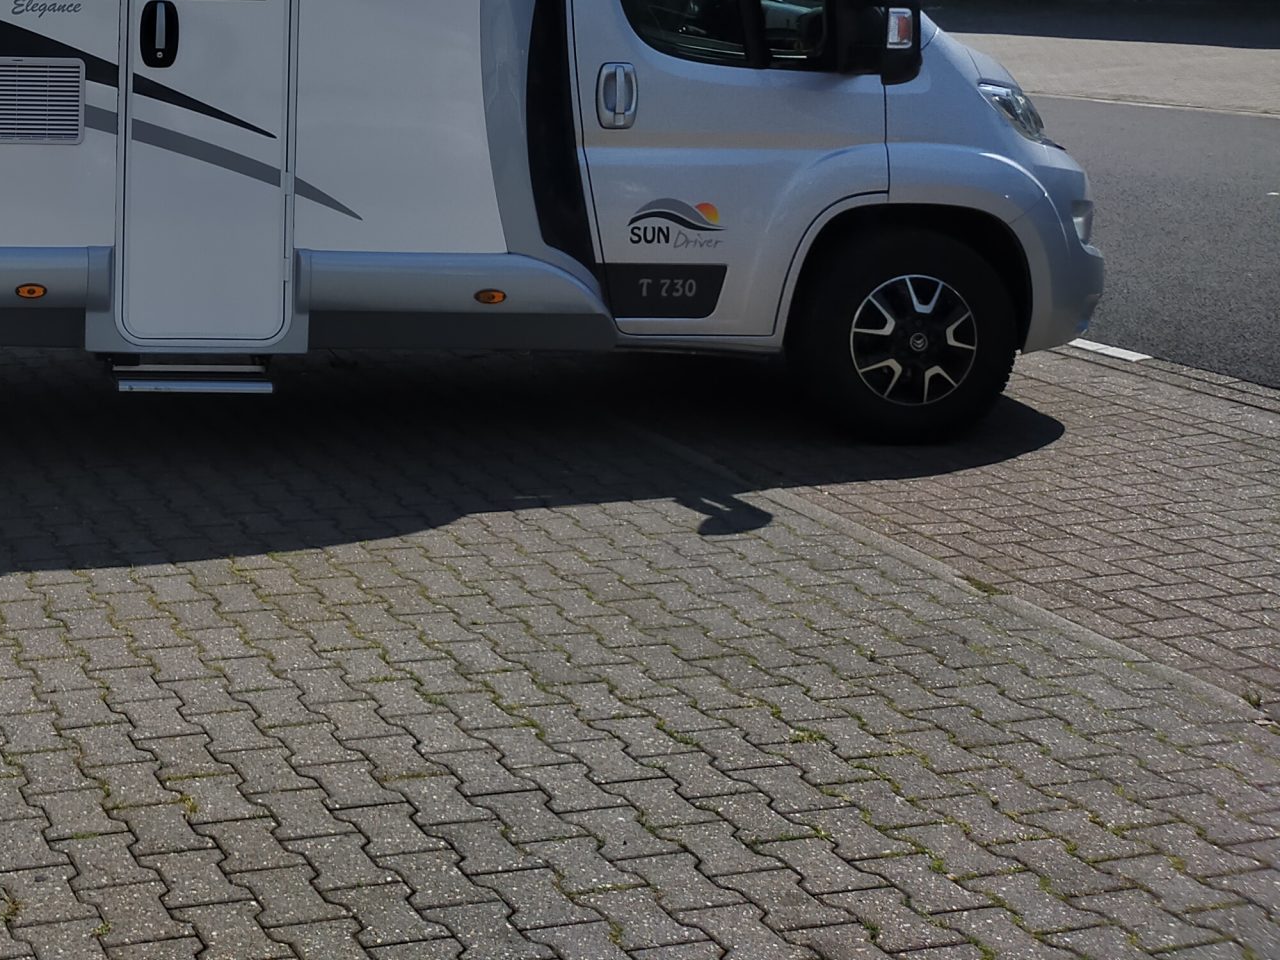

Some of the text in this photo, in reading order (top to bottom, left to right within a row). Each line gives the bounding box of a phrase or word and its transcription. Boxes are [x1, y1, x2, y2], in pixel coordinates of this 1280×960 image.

[629, 226, 724, 249] SUN Driver
[639, 279, 697, 297] T 730
